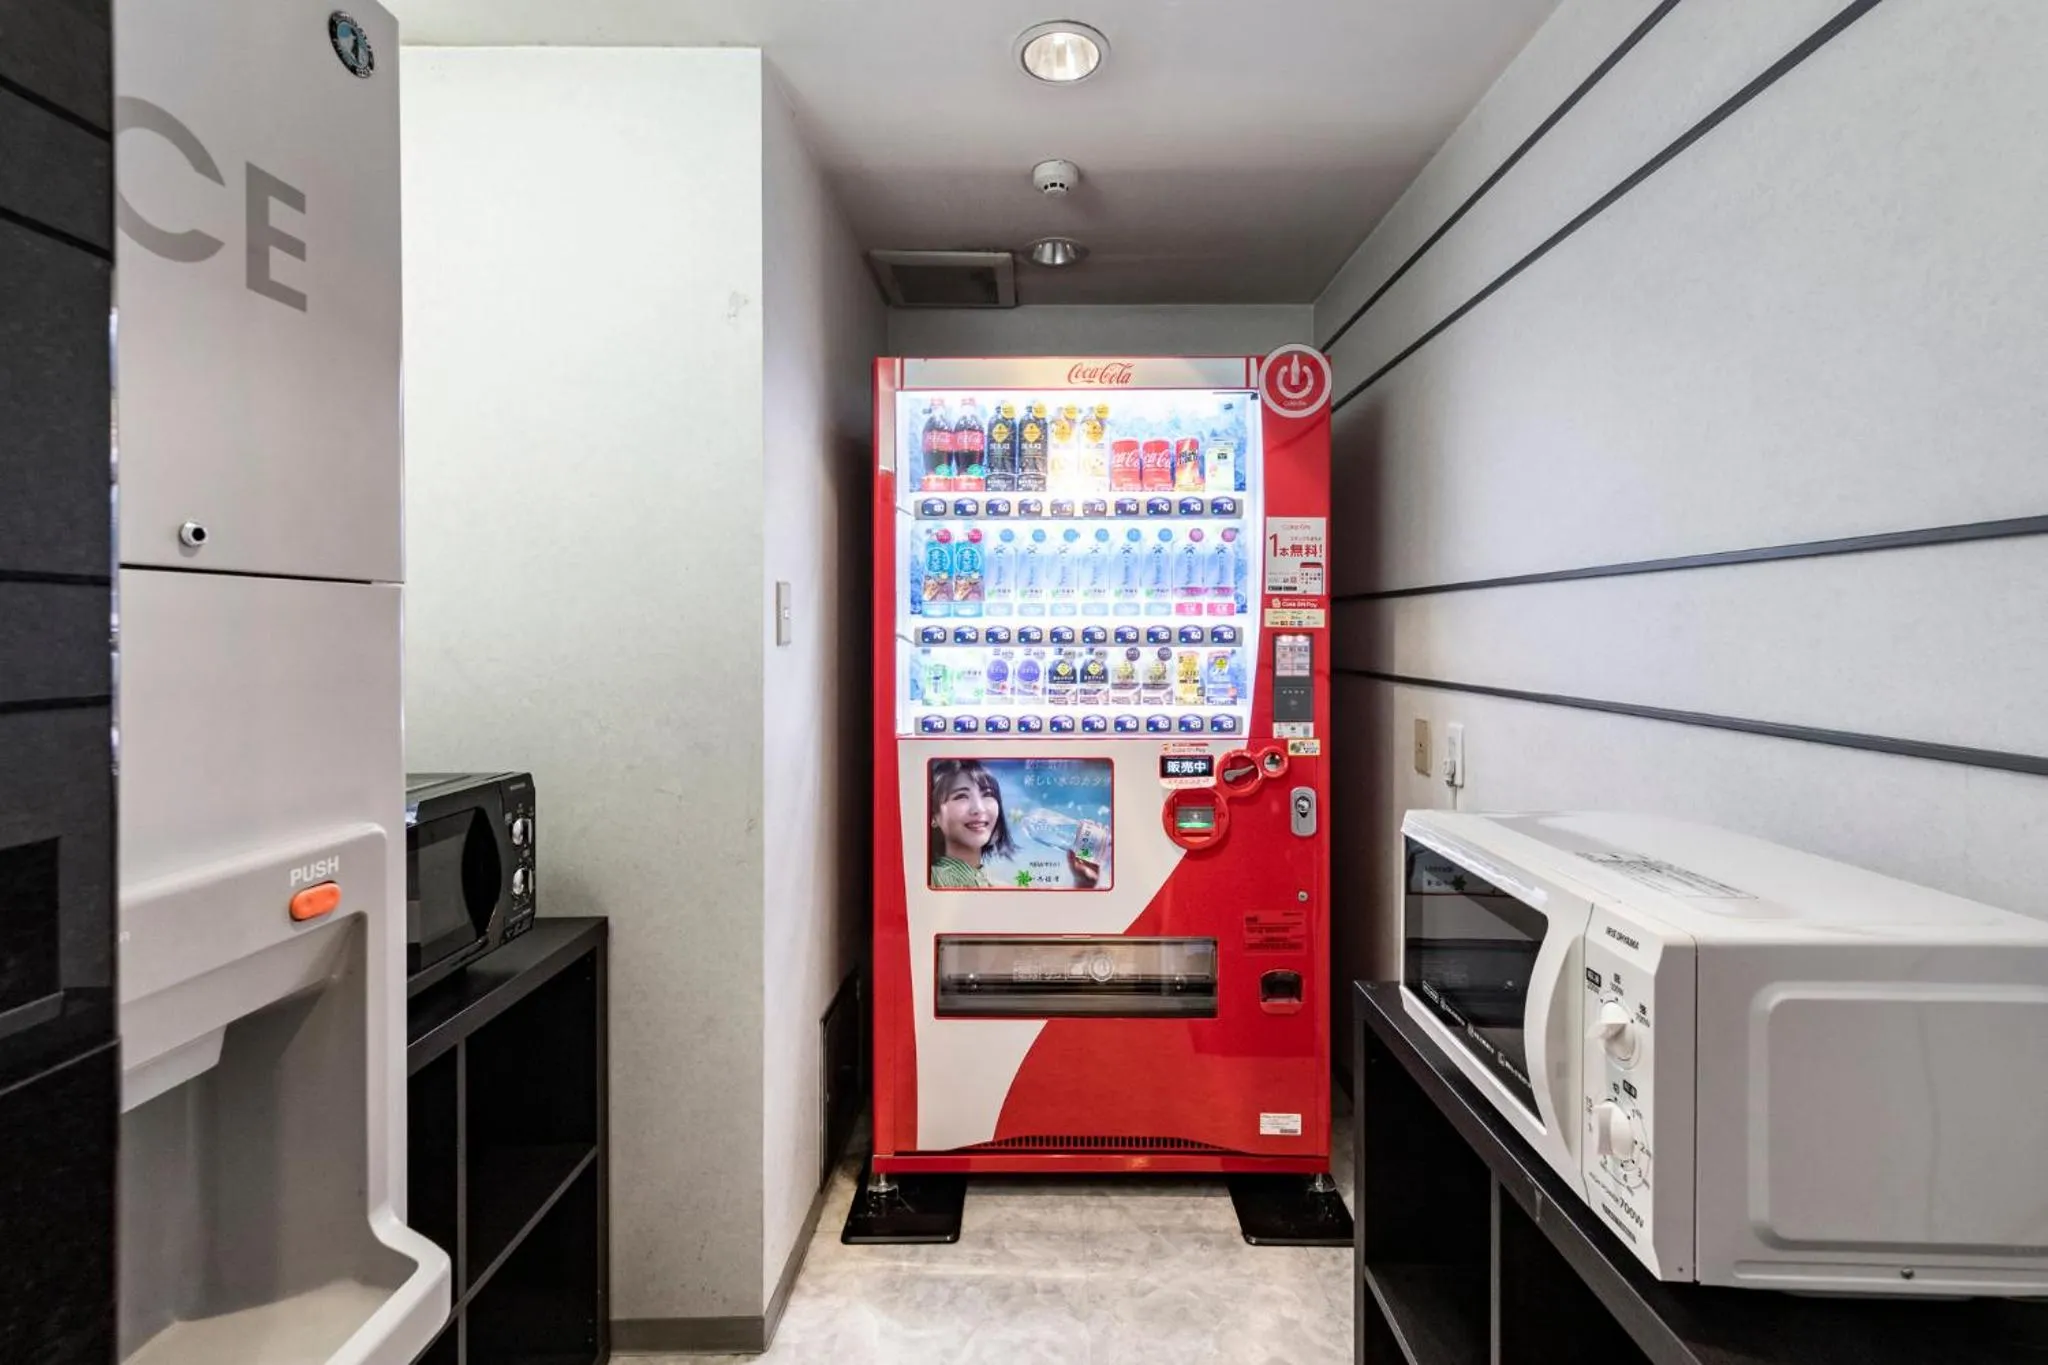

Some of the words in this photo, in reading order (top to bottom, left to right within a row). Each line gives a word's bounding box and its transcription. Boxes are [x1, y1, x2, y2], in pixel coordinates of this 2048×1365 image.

[1067, 362, 1135, 385] Coca-Cola
[1269, 533, 1322, 558] 1本無料!
[1167, 761, 1206, 773] 販売中
[290, 855, 340, 887] PUSH
